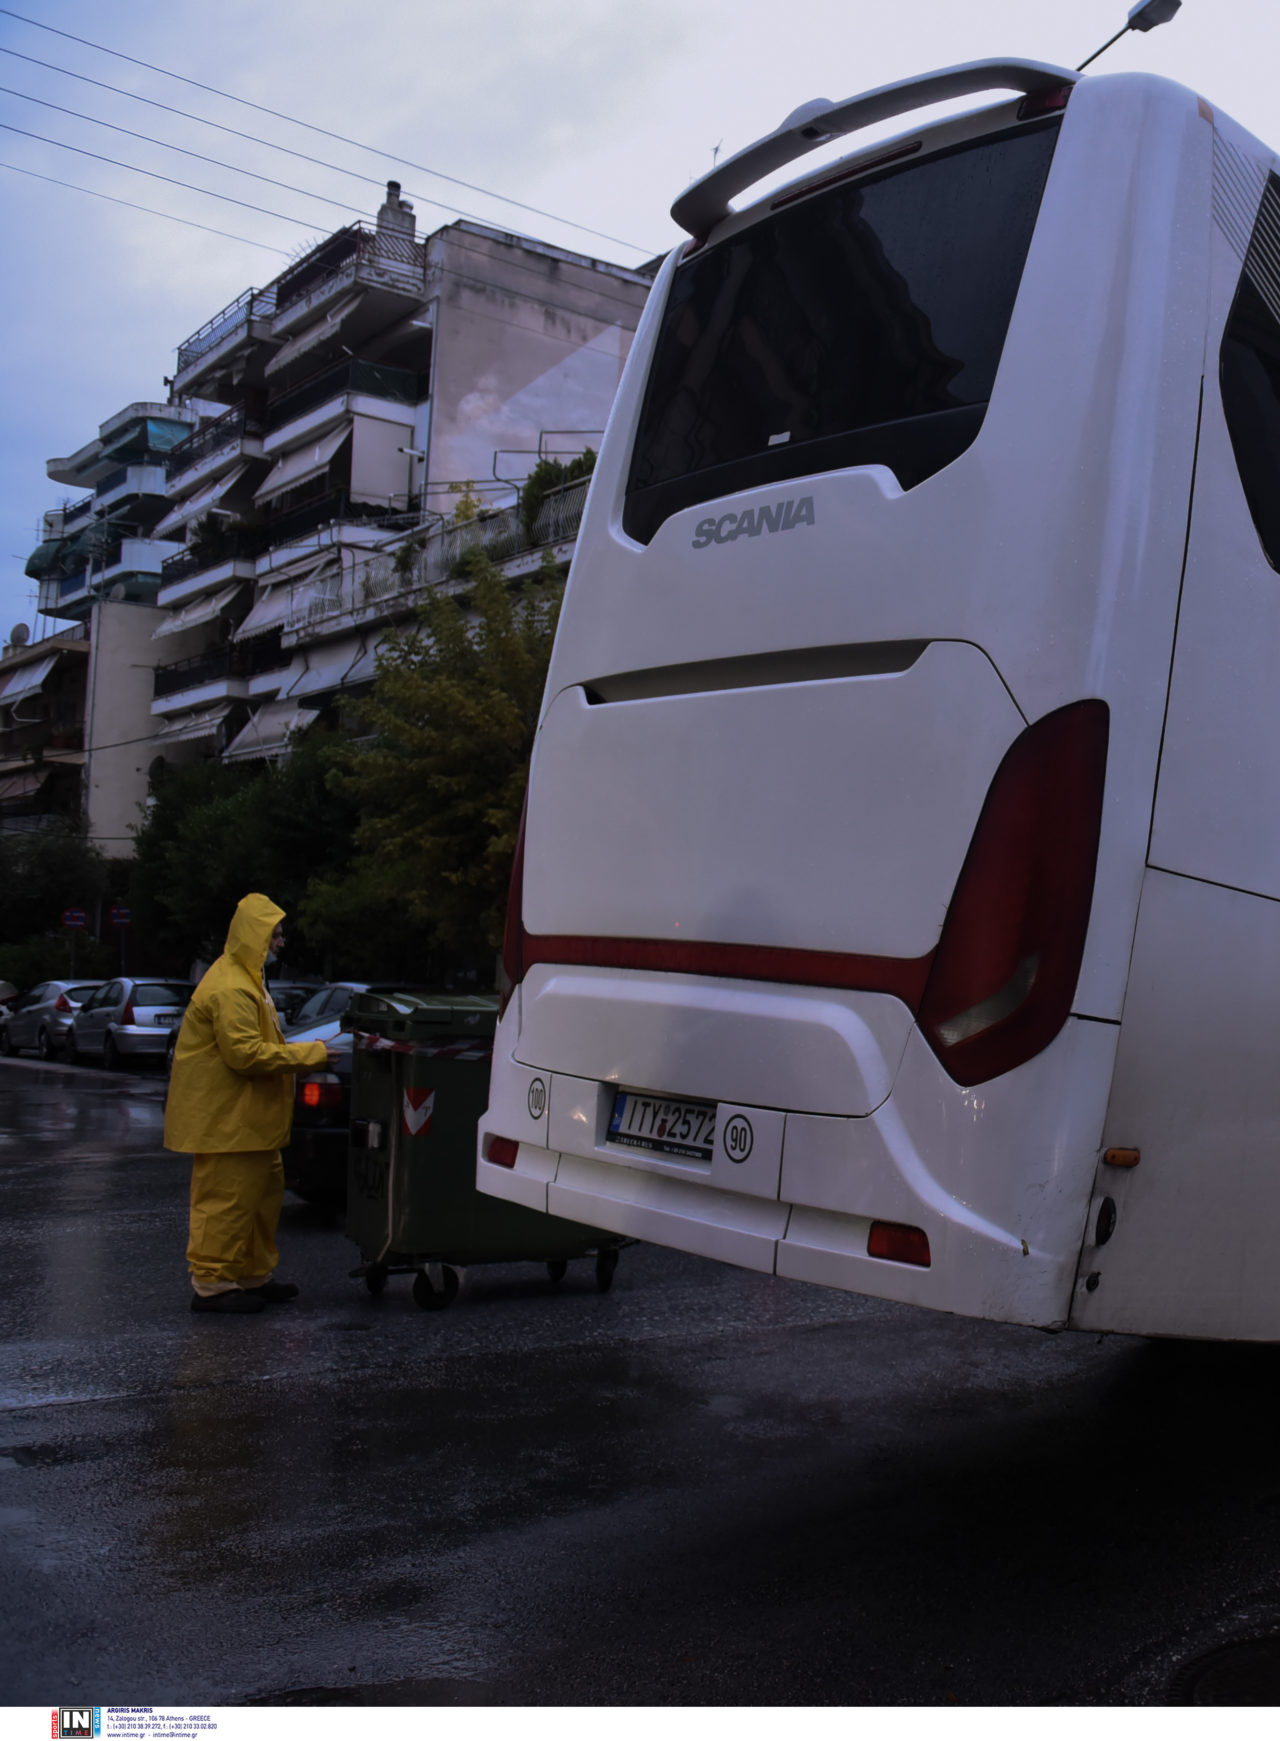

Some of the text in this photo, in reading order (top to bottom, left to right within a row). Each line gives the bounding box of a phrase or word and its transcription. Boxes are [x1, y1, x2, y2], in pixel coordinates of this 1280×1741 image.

[691, 496, 816, 549] SCANIA
[530, 1087, 544, 1110] 100
[731, 1126, 747, 1153] 90
